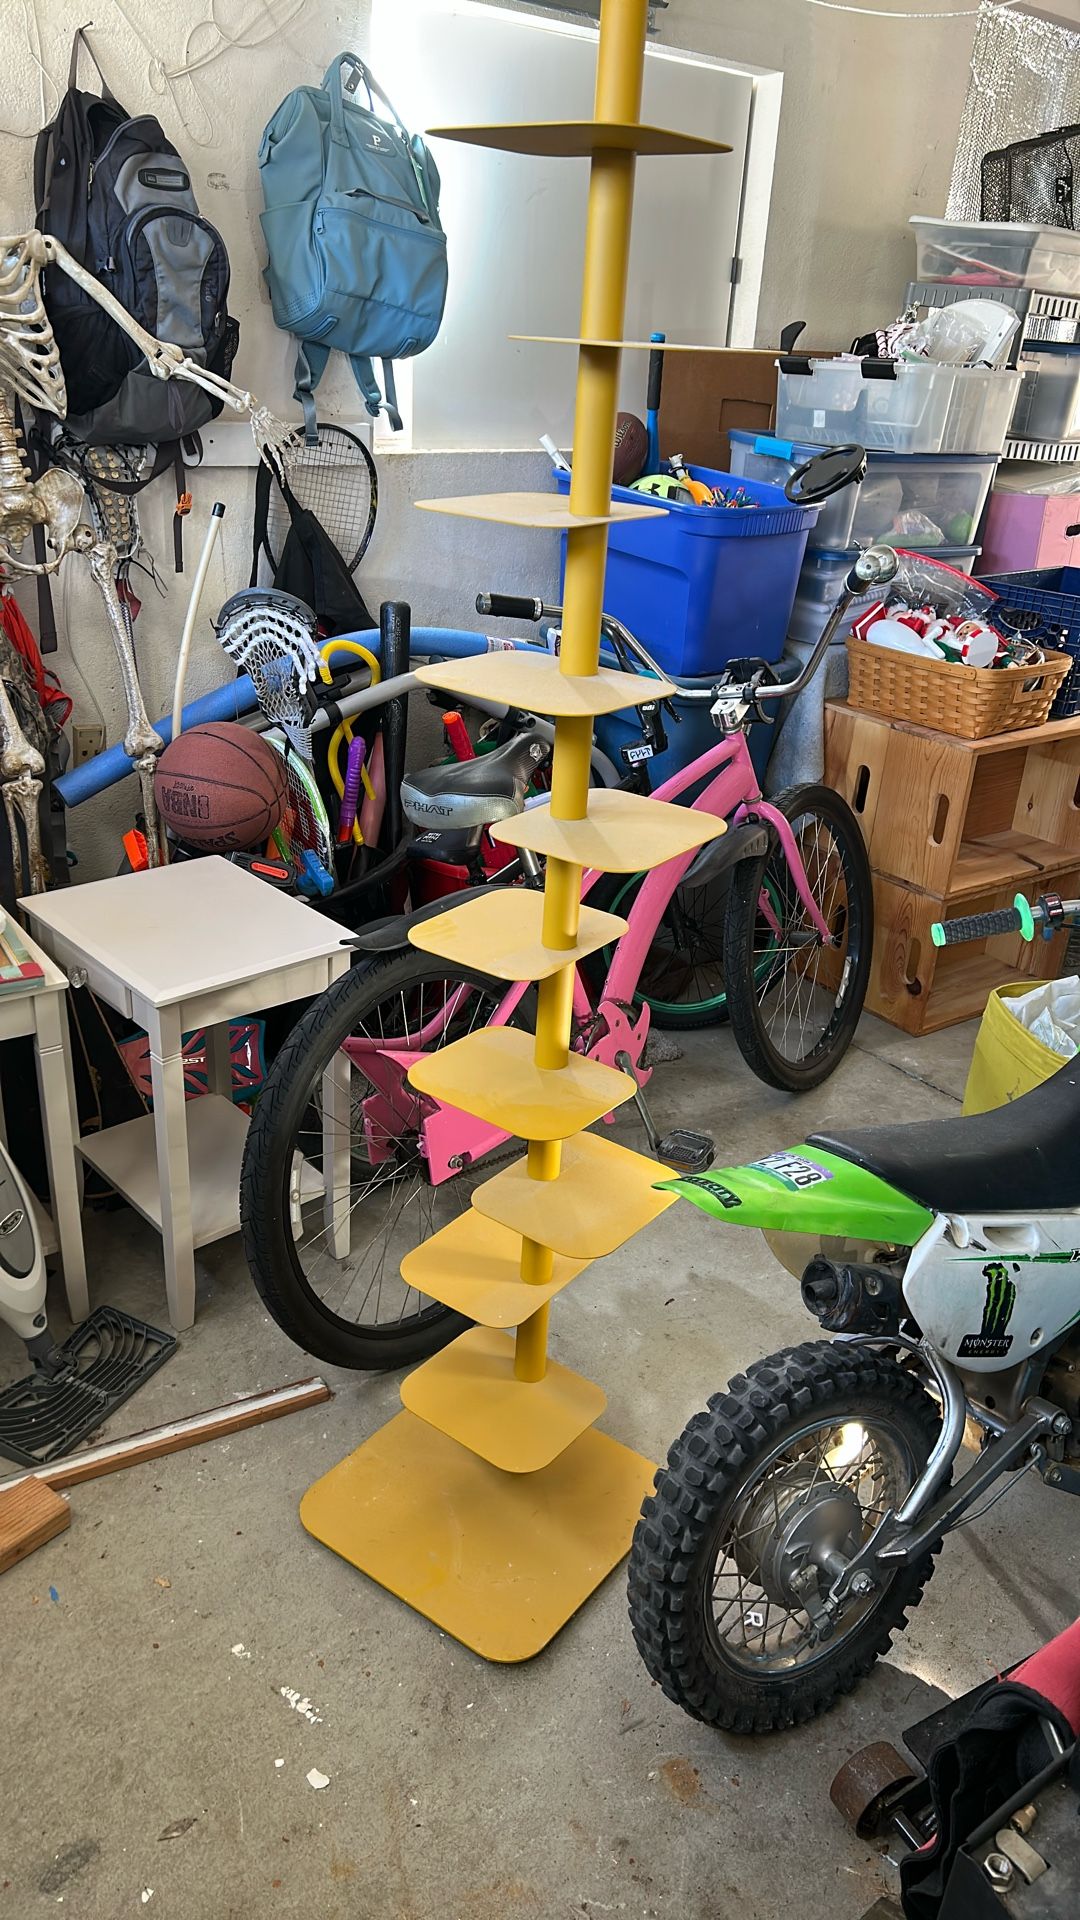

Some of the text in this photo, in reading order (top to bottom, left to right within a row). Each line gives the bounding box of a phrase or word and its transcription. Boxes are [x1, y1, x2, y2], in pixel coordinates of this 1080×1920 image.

[372, 134, 382, 146] P
[404, 799, 454, 817] PHAT
[963, 1338, 1009, 1349] MONSTER
